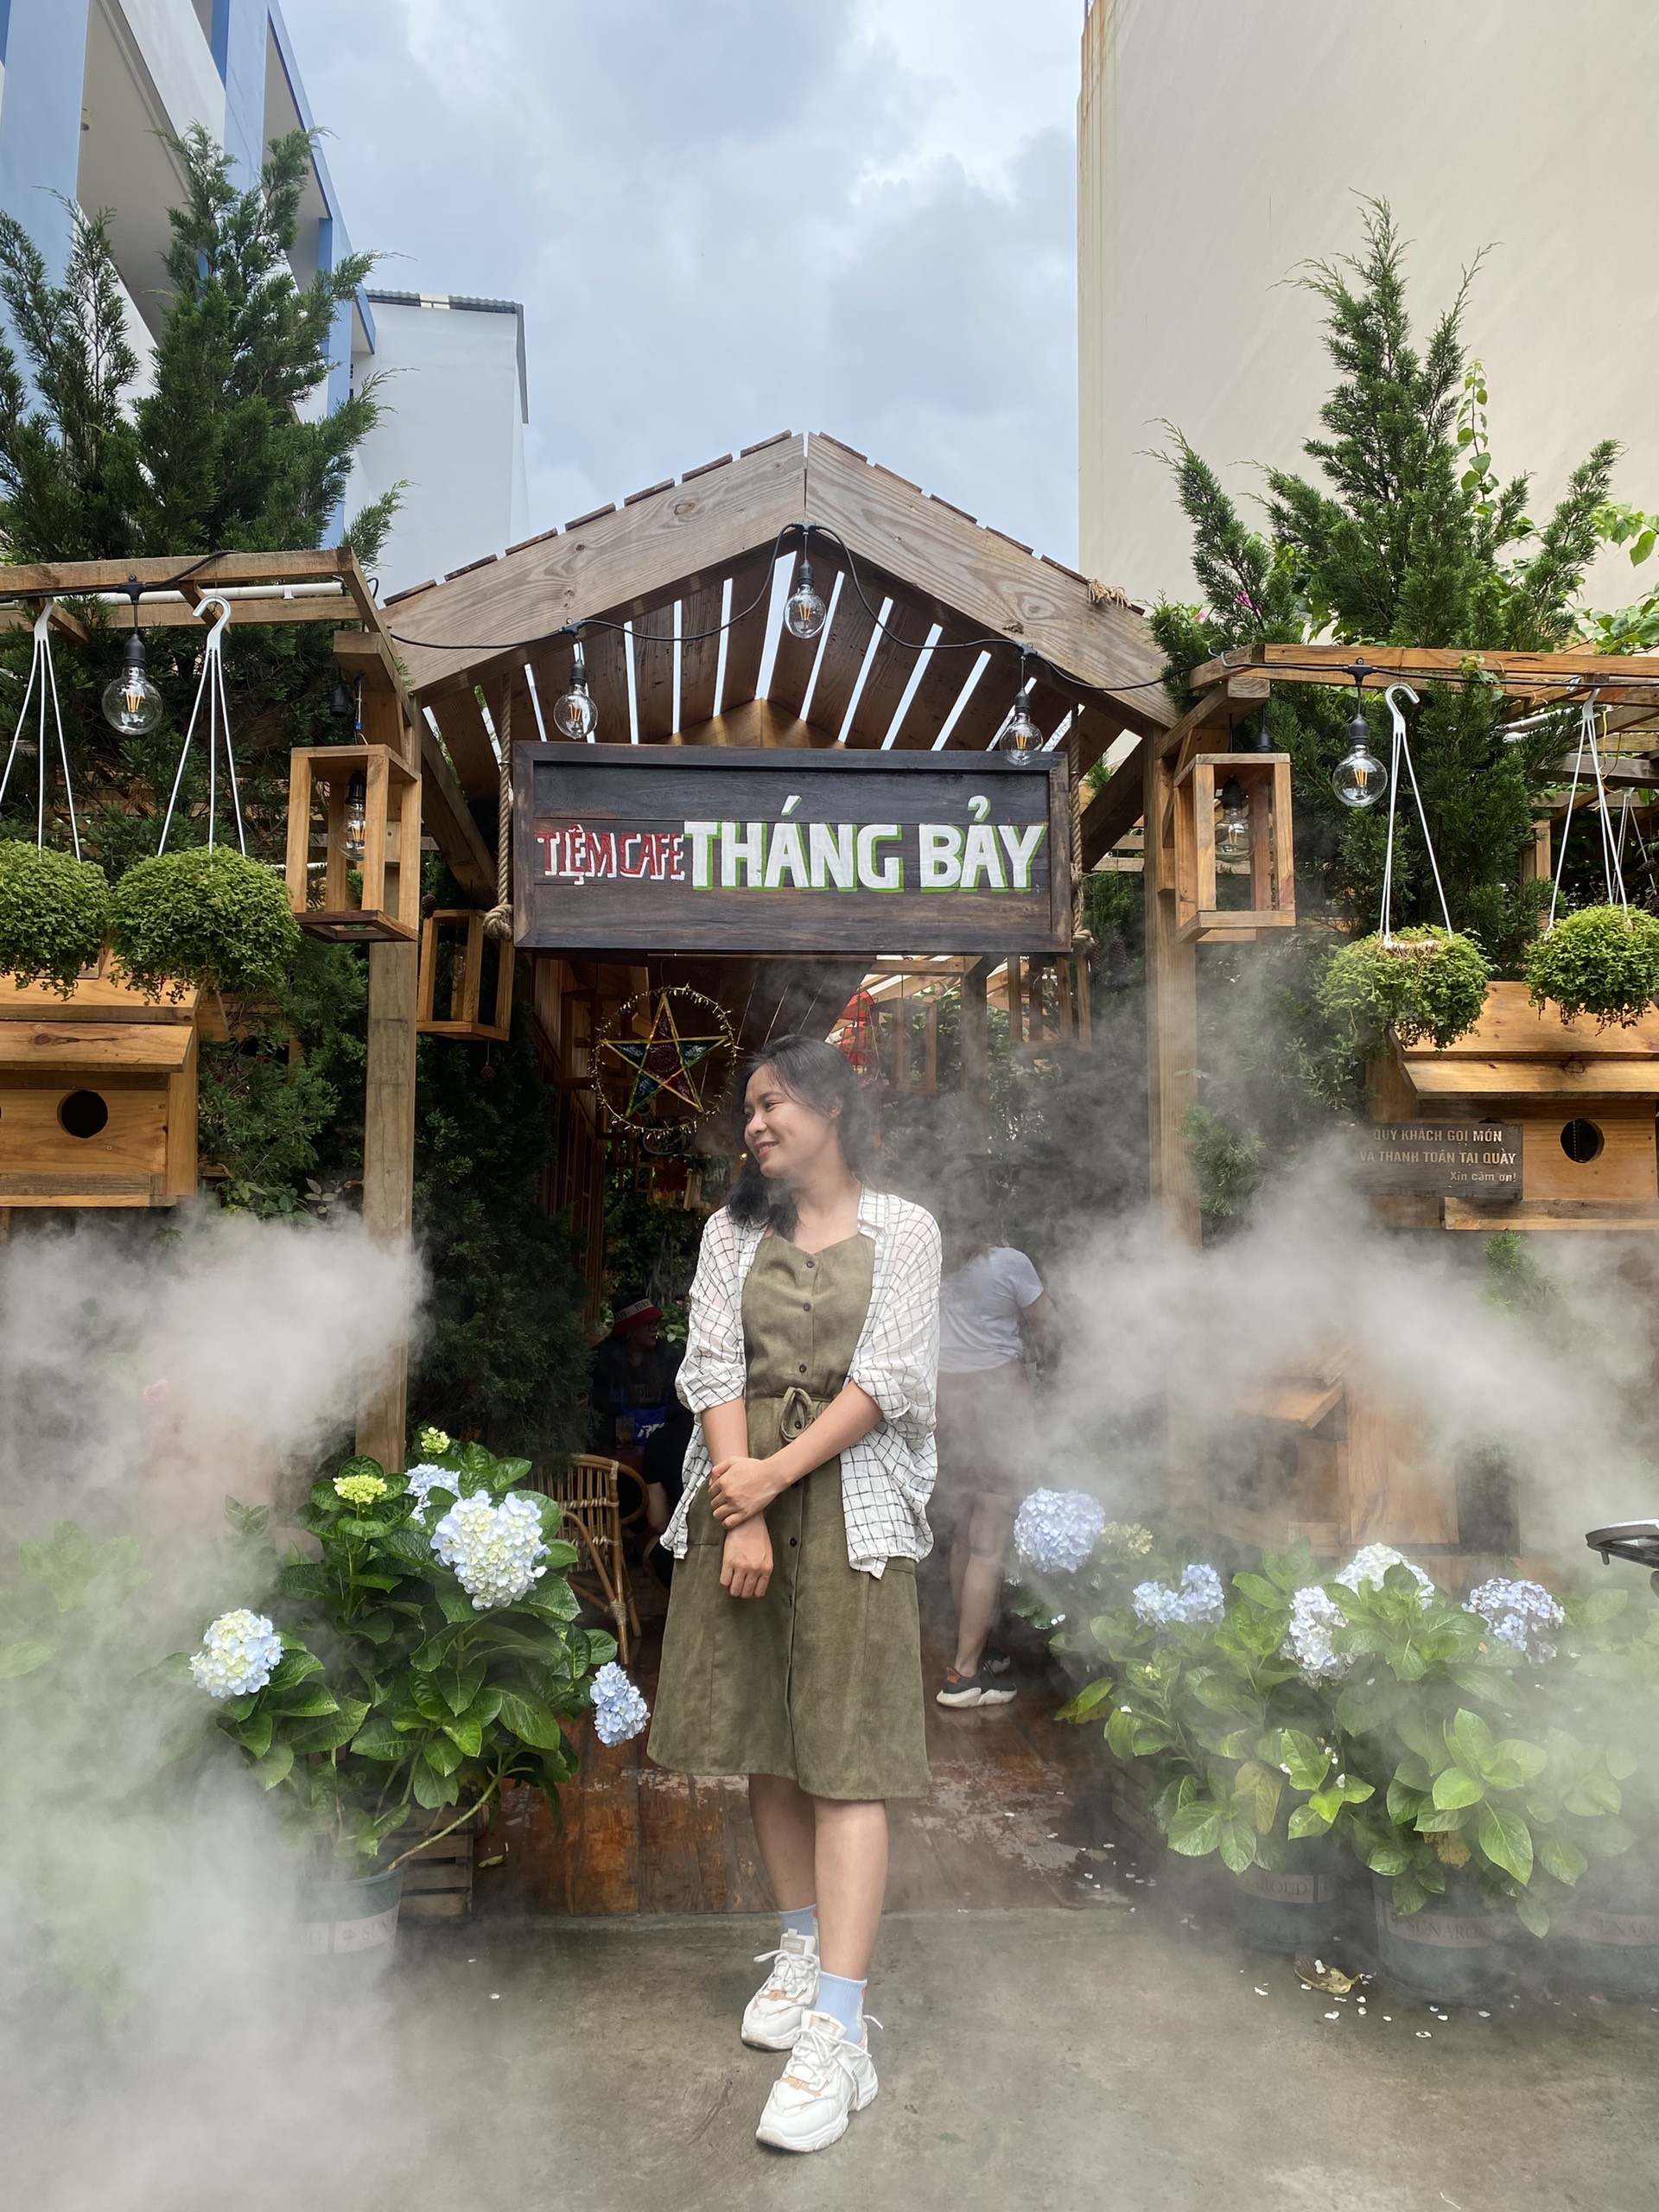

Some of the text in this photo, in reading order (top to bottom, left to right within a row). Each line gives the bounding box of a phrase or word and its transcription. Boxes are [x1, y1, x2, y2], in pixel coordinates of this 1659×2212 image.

[537, 795, 1048, 893] TIỆM CAFE THÁNG BẢY
[1402, 1128, 1442, 1141] KHÁCH
[1473, 1128, 1503, 1142] MÓN
[1378, 1151, 1419, 1162] THANH
[1423, 1148, 1455, 1163] TOÁN
[1459, 1152, 1478, 1166] TẠI
[1451, 1172, 1467, 1181] Xin
